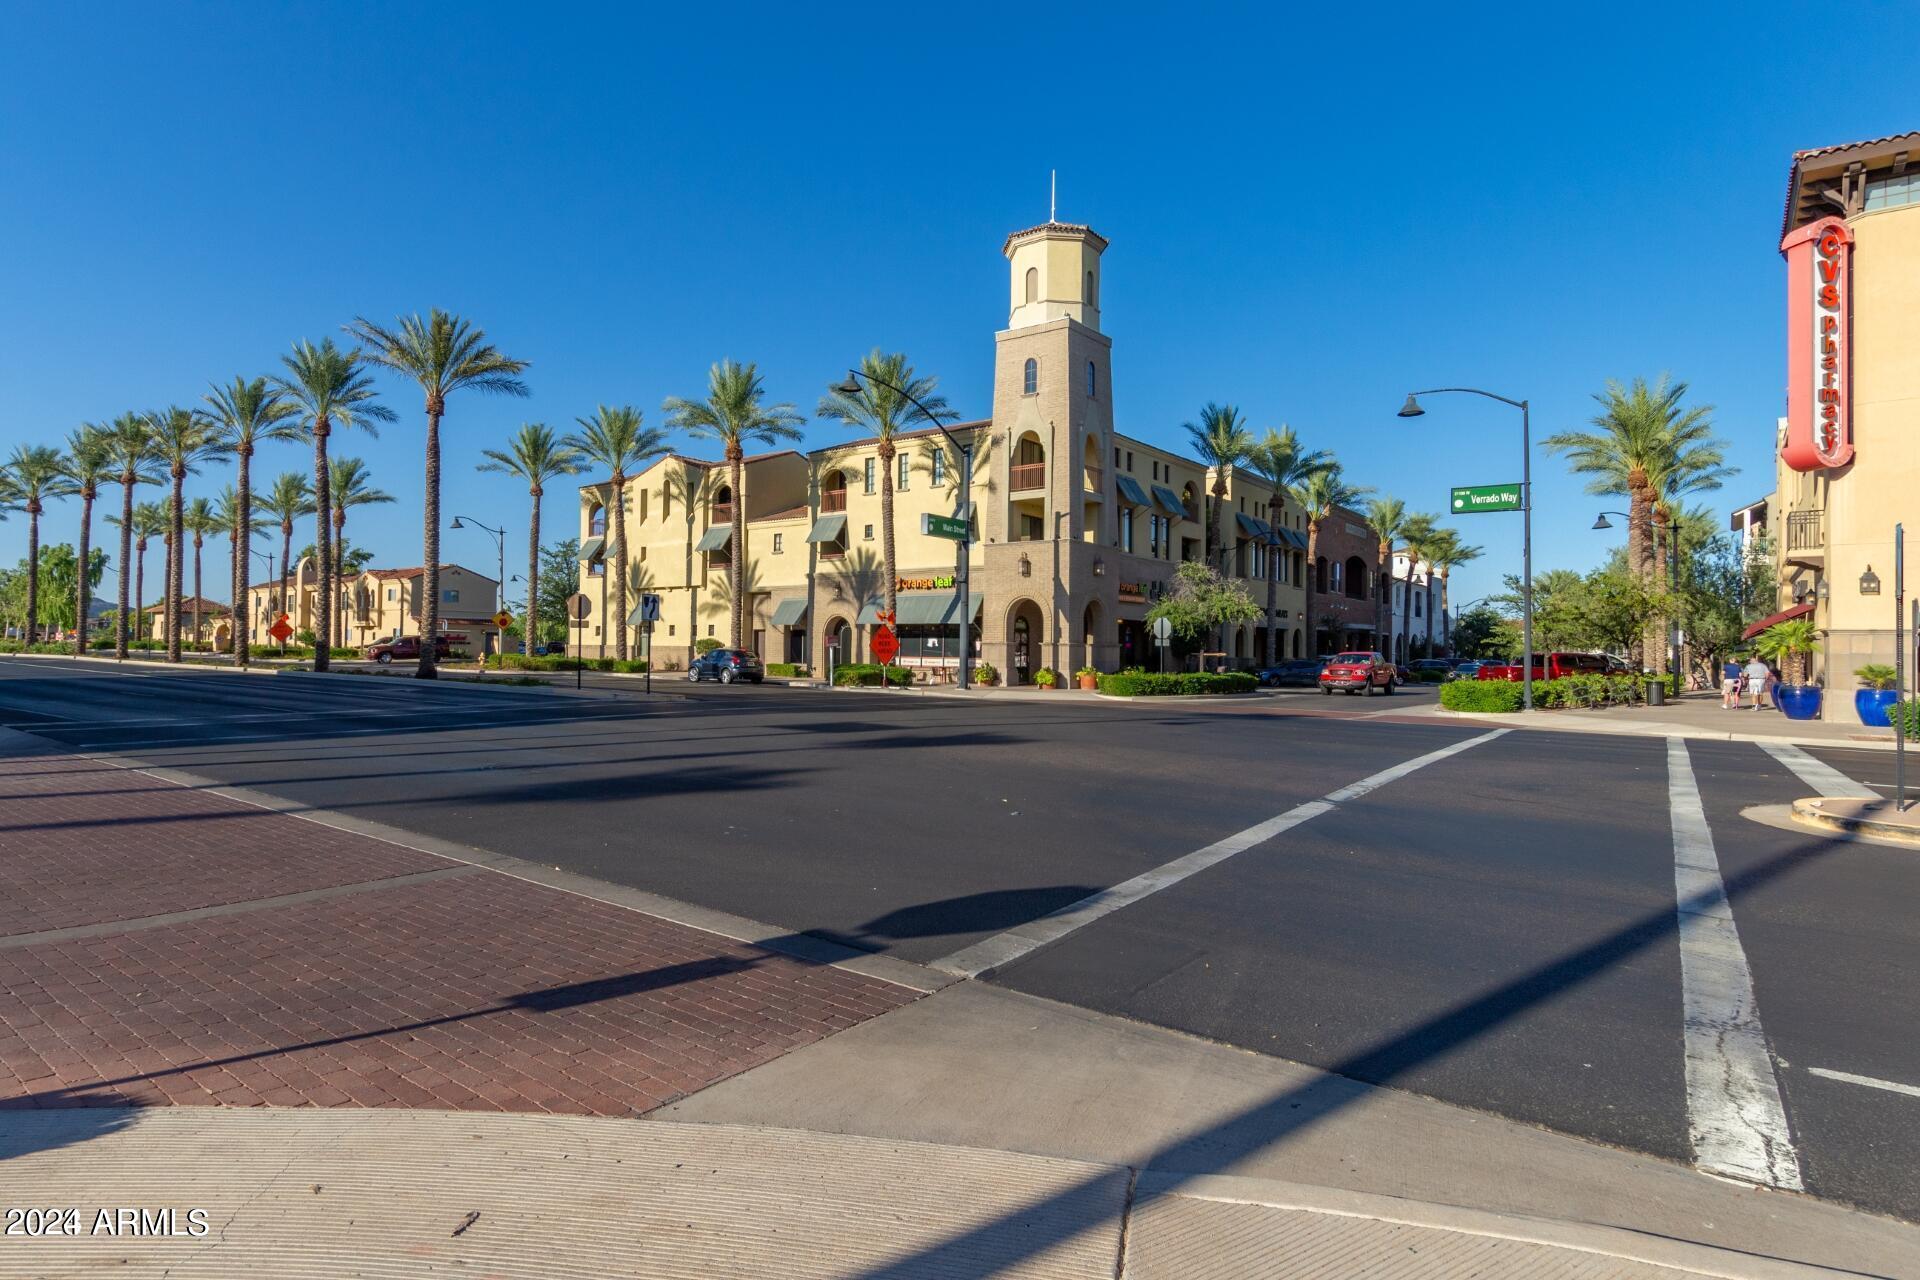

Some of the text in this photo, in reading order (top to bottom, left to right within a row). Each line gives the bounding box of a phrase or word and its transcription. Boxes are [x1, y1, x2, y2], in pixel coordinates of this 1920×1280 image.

[1818, 234, 1841, 454] CVS pharmacy
[1471, 493, 1500, 504] Verrado
[1501, 492, 1518, 504] Way
[902, 575, 955, 590] orange leaf
